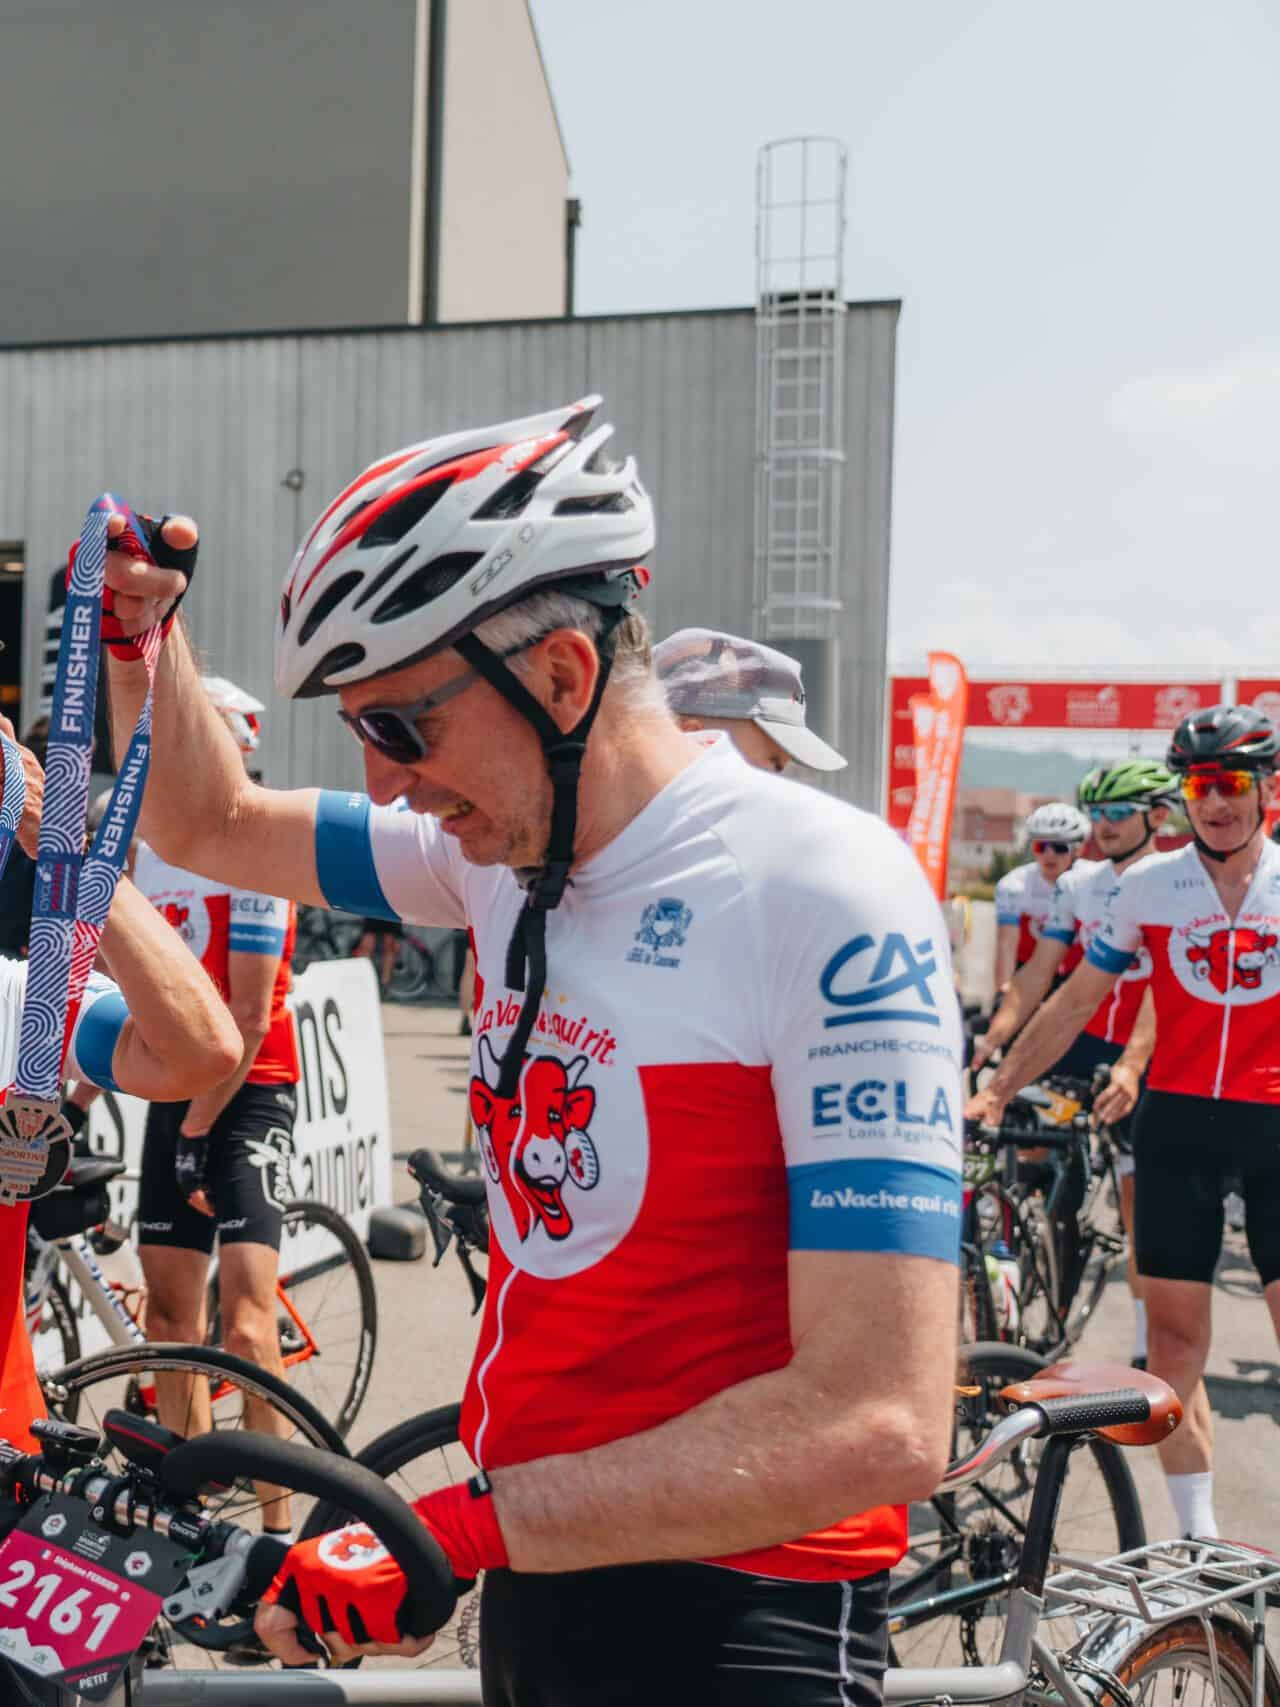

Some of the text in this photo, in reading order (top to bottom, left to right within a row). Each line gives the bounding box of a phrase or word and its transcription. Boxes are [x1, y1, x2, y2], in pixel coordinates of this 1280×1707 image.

[61, 605, 93, 733] FINISHER
[98, 743, 149, 858] FINISHER
[293, 997, 348, 1122] ns
[551, 1014, 589, 1048] qui
[580, 1028, 617, 1066] rit
[812, 1079, 954, 1134] ECLA
[810, 1188, 834, 1209] La
[833, 1187, 908, 1209] Vache
[911, 1194, 942, 1214] qui
[80, 1672, 109, 1689] PETIT
